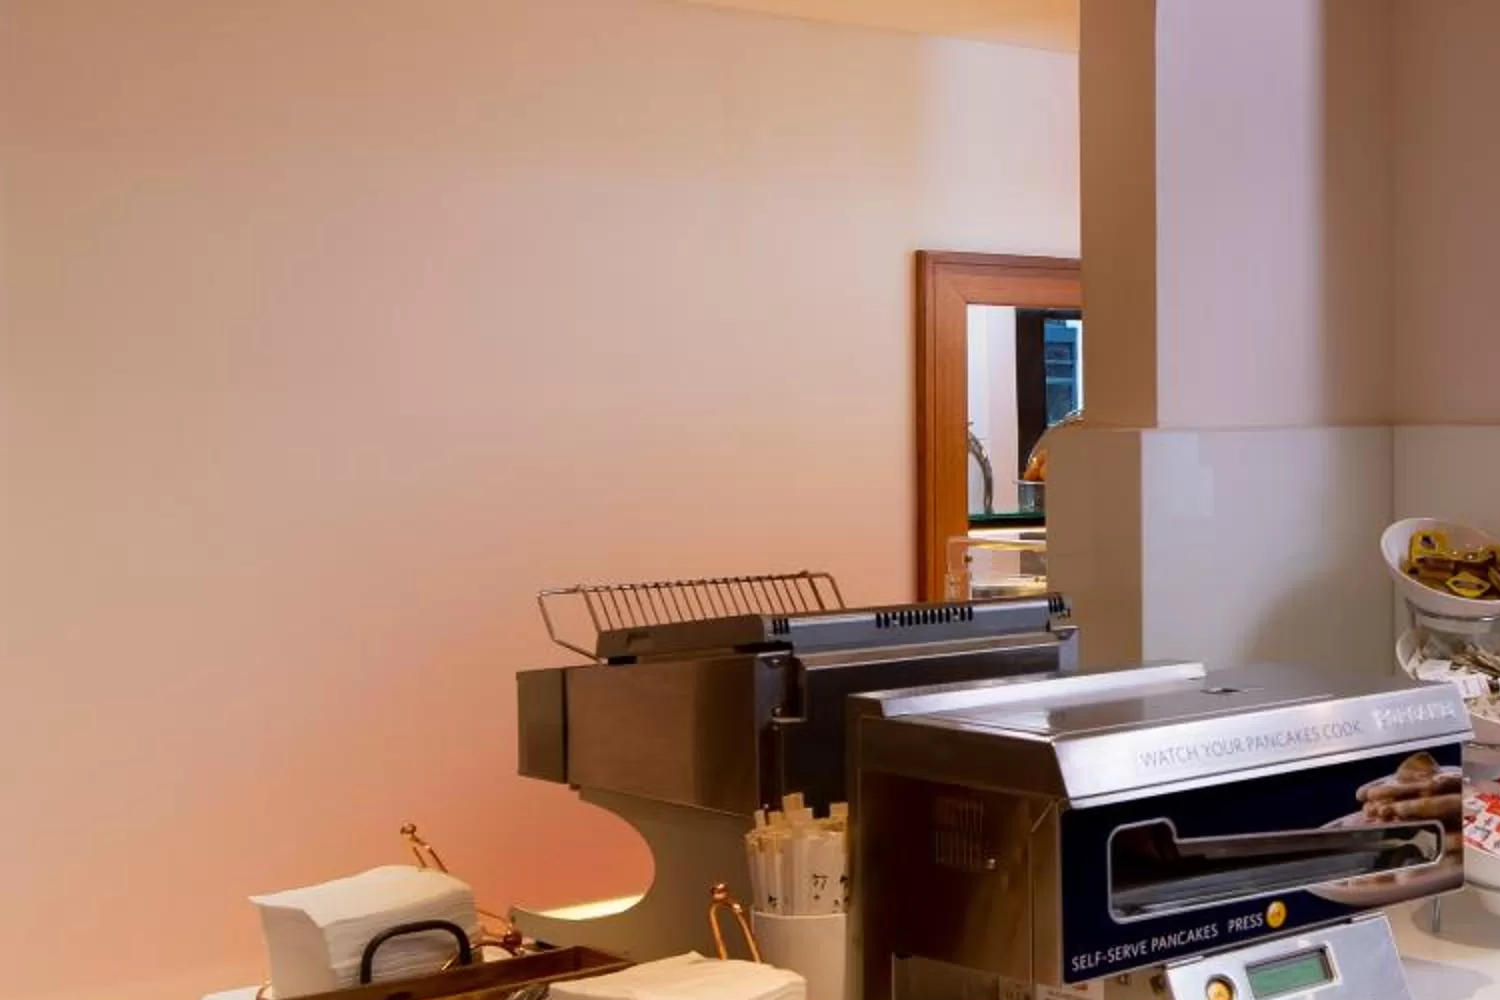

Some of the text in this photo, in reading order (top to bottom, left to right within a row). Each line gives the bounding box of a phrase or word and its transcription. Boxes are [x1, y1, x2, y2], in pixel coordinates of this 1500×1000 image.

[1138, 720, 1364, 769] WATCH YOUR PANCAKES COOK
[1071, 939, 1148, 973] SELF-SERVE
[1151, 922, 1219, 951] PANCAKES
[1227, 912, 1264, 934] PRESS
